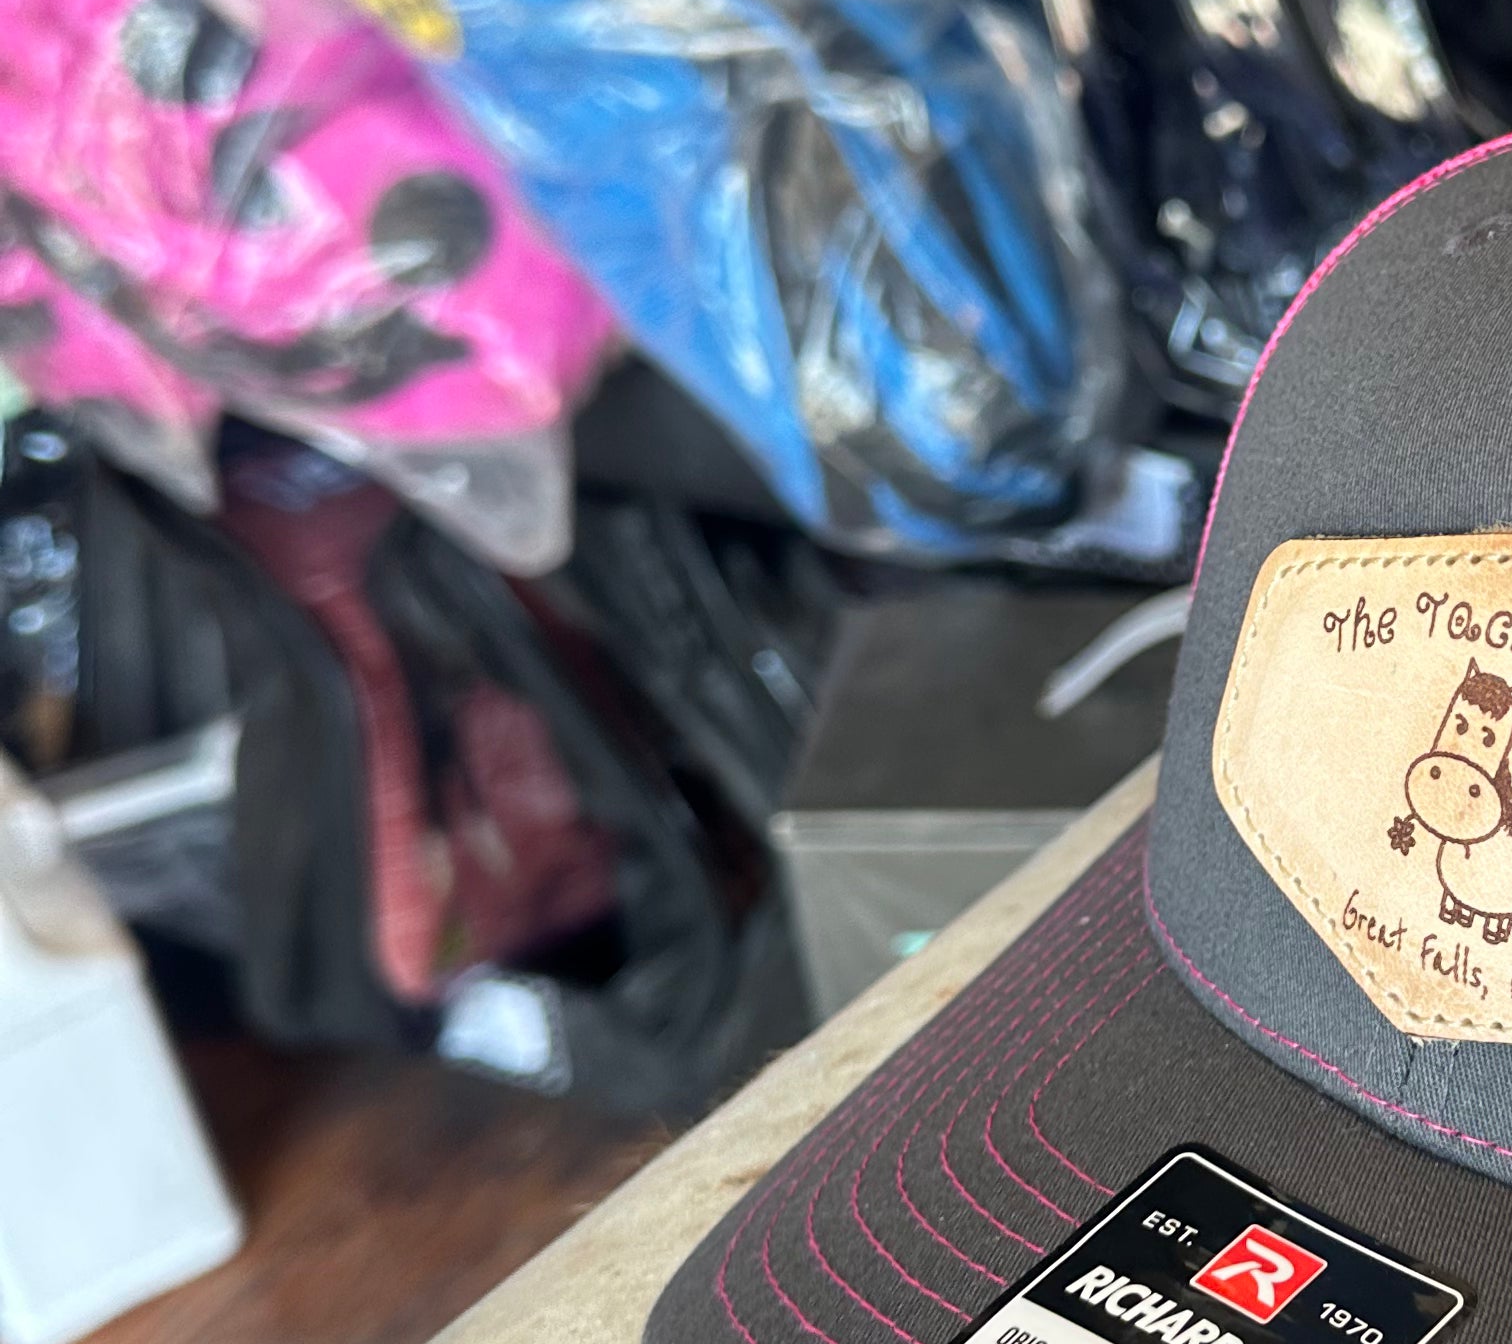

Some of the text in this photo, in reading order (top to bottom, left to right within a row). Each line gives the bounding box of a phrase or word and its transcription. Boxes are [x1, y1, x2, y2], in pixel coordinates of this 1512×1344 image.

[1323, 597, 1397, 653] The
[1341, 889, 1408, 952] Great
[1420, 936, 1489, 1000] Falls,
[1142, 1210, 1199, 1246] EST.
